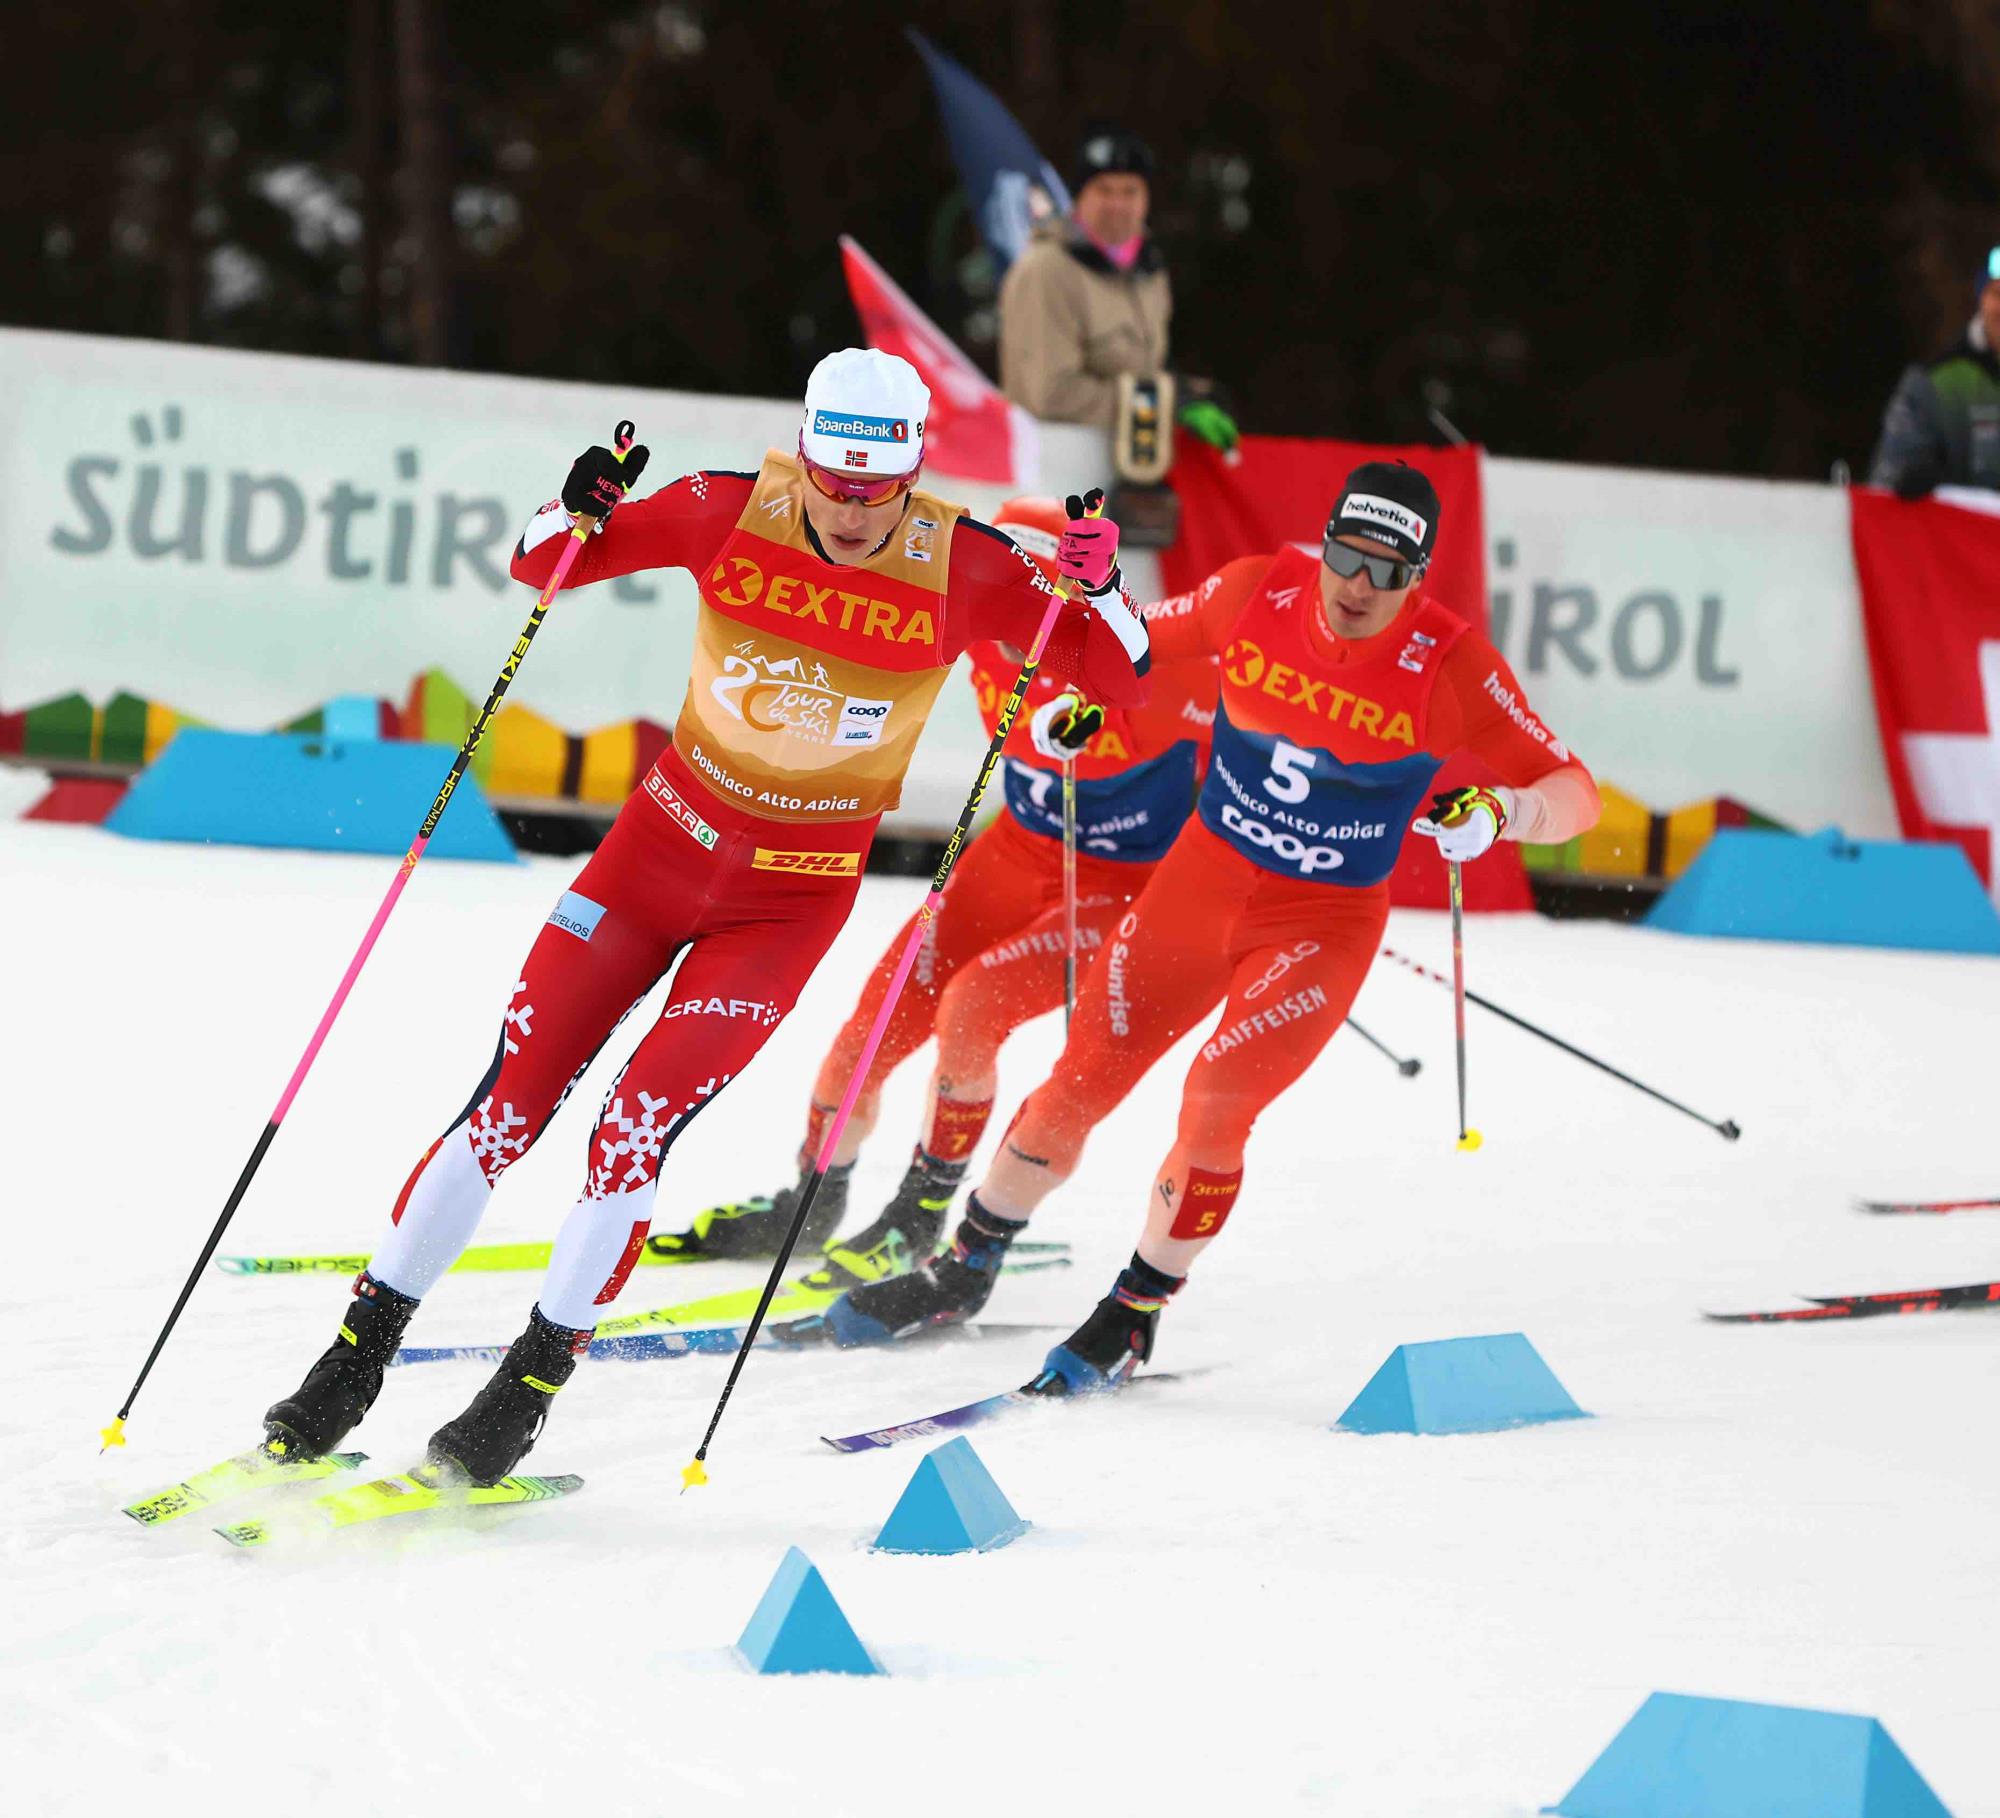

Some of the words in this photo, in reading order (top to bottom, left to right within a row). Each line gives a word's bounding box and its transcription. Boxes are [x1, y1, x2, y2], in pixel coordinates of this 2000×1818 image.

[816, 416, 890, 437] SpareBank
[896, 424, 903, 437] 1
[1347, 501, 1408, 527] helvetia
[764, 575, 935, 645] EXTRA
[505, 617, 541, 682] LEKI
[848, 706, 888, 718] coop
[995, 674, 1030, 738] LEKI
[1262, 662, 1415, 747] EXTRA
[1483, 671, 1548, 744] helvetia
[692, 744, 753, 798] Dobbiaco
[1215, 754, 1269, 816] Dobbiaco
[1262, 740, 1317, 804] 5
[648, 775, 697, 830] SPAR
[767, 854, 848, 872] DHL
[1222, 804, 1345, 874] coop
[978, 927, 1103, 970] RAIFFEIEN
[664, 997, 766, 1021] CRAFT
[1107, 942, 1131, 1037] Sunrise
[1202, 984, 1329, 1063] RAIFFEISEN
[951, 1133, 968, 1152] 7
[1195, 1211, 1217, 1232] 5
[255, 1256, 368, 1274] ISCHER
